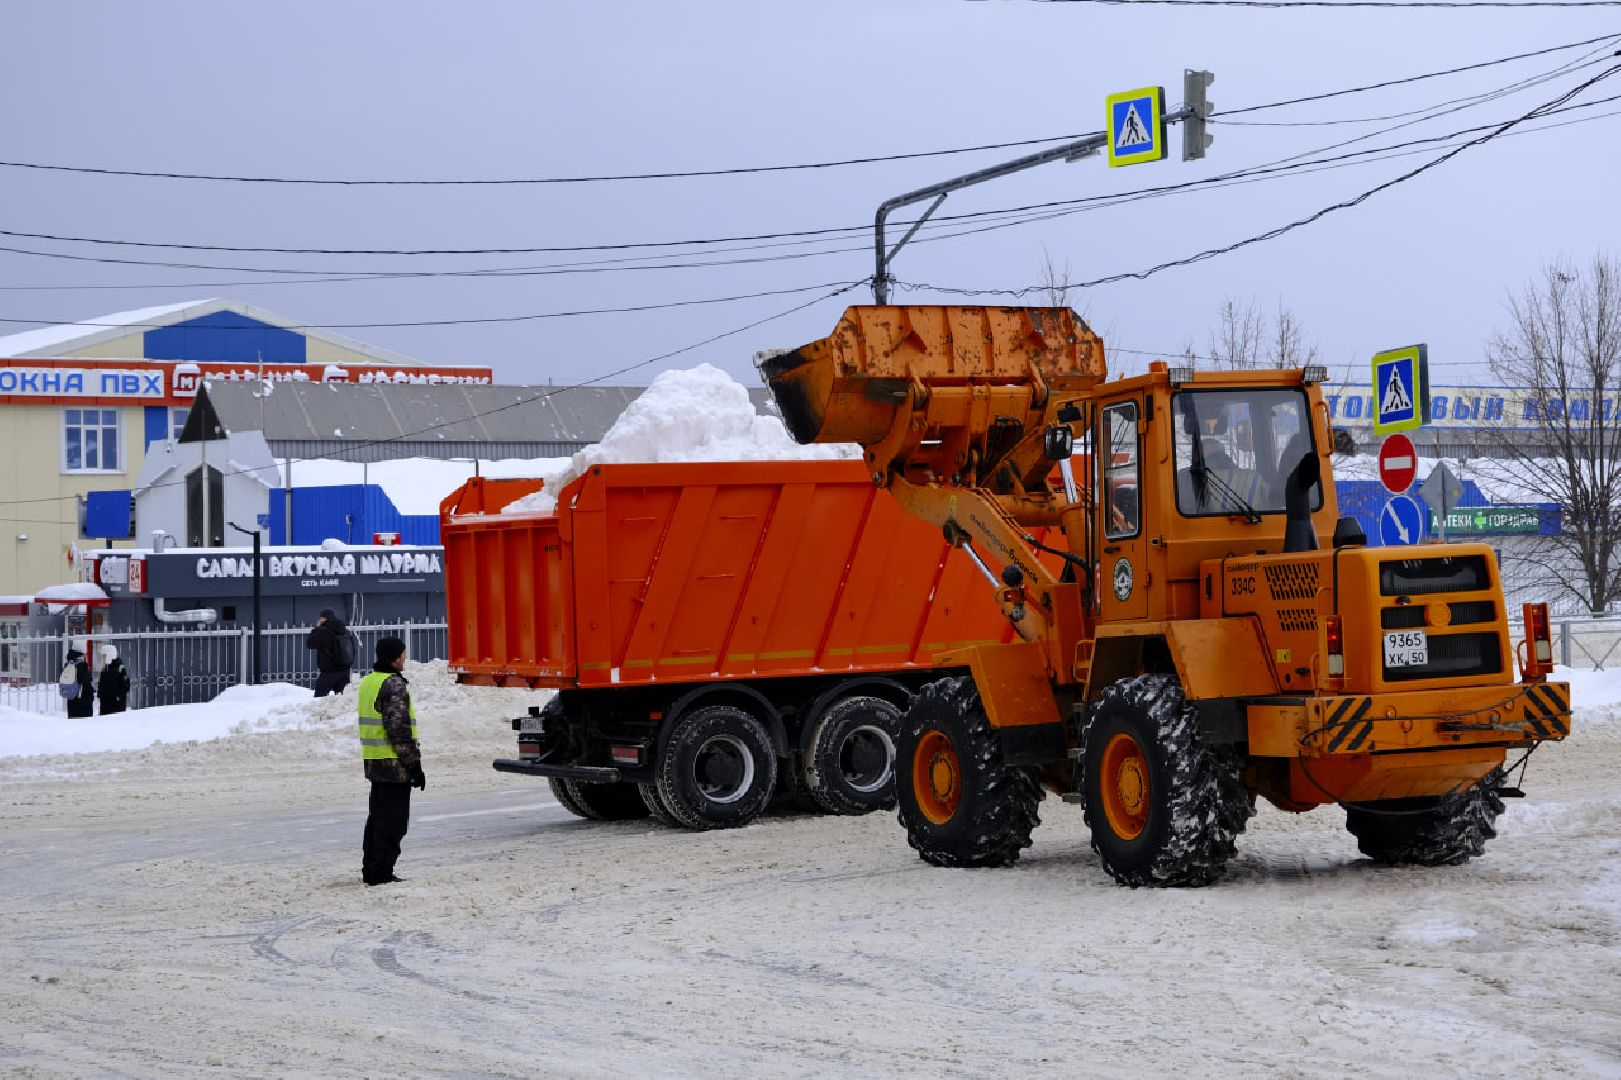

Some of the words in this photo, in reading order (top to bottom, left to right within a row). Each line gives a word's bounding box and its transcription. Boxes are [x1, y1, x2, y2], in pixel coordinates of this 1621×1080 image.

[0, 372, 83, 392] ОКНА
[101, 373, 161, 394] ПВХ
[269, 554, 356, 577] ВКУСНАЯ
[1389, 633, 1421, 648] 9365
[1412, 650, 1425, 663] 50
